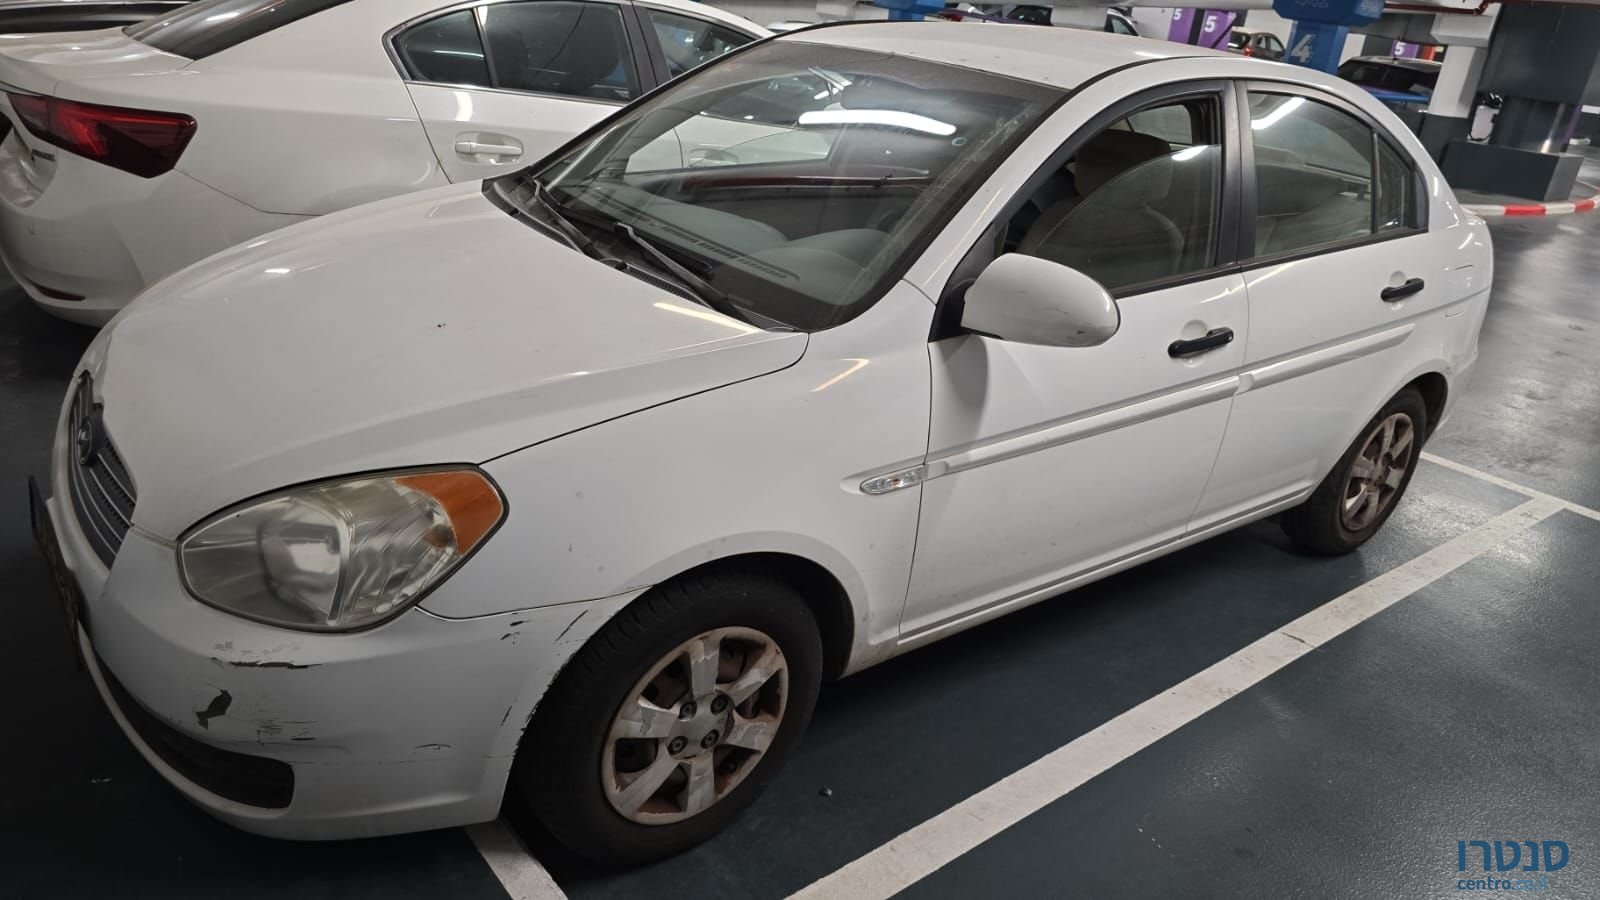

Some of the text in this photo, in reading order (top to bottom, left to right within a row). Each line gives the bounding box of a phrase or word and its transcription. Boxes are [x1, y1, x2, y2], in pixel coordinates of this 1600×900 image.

[1173, 8, 1183, 20] 5
[1204, 15, 1217, 33] 5
[1291, 33, 1314, 63] 4
[1394, 41, 1407, 56] 5
